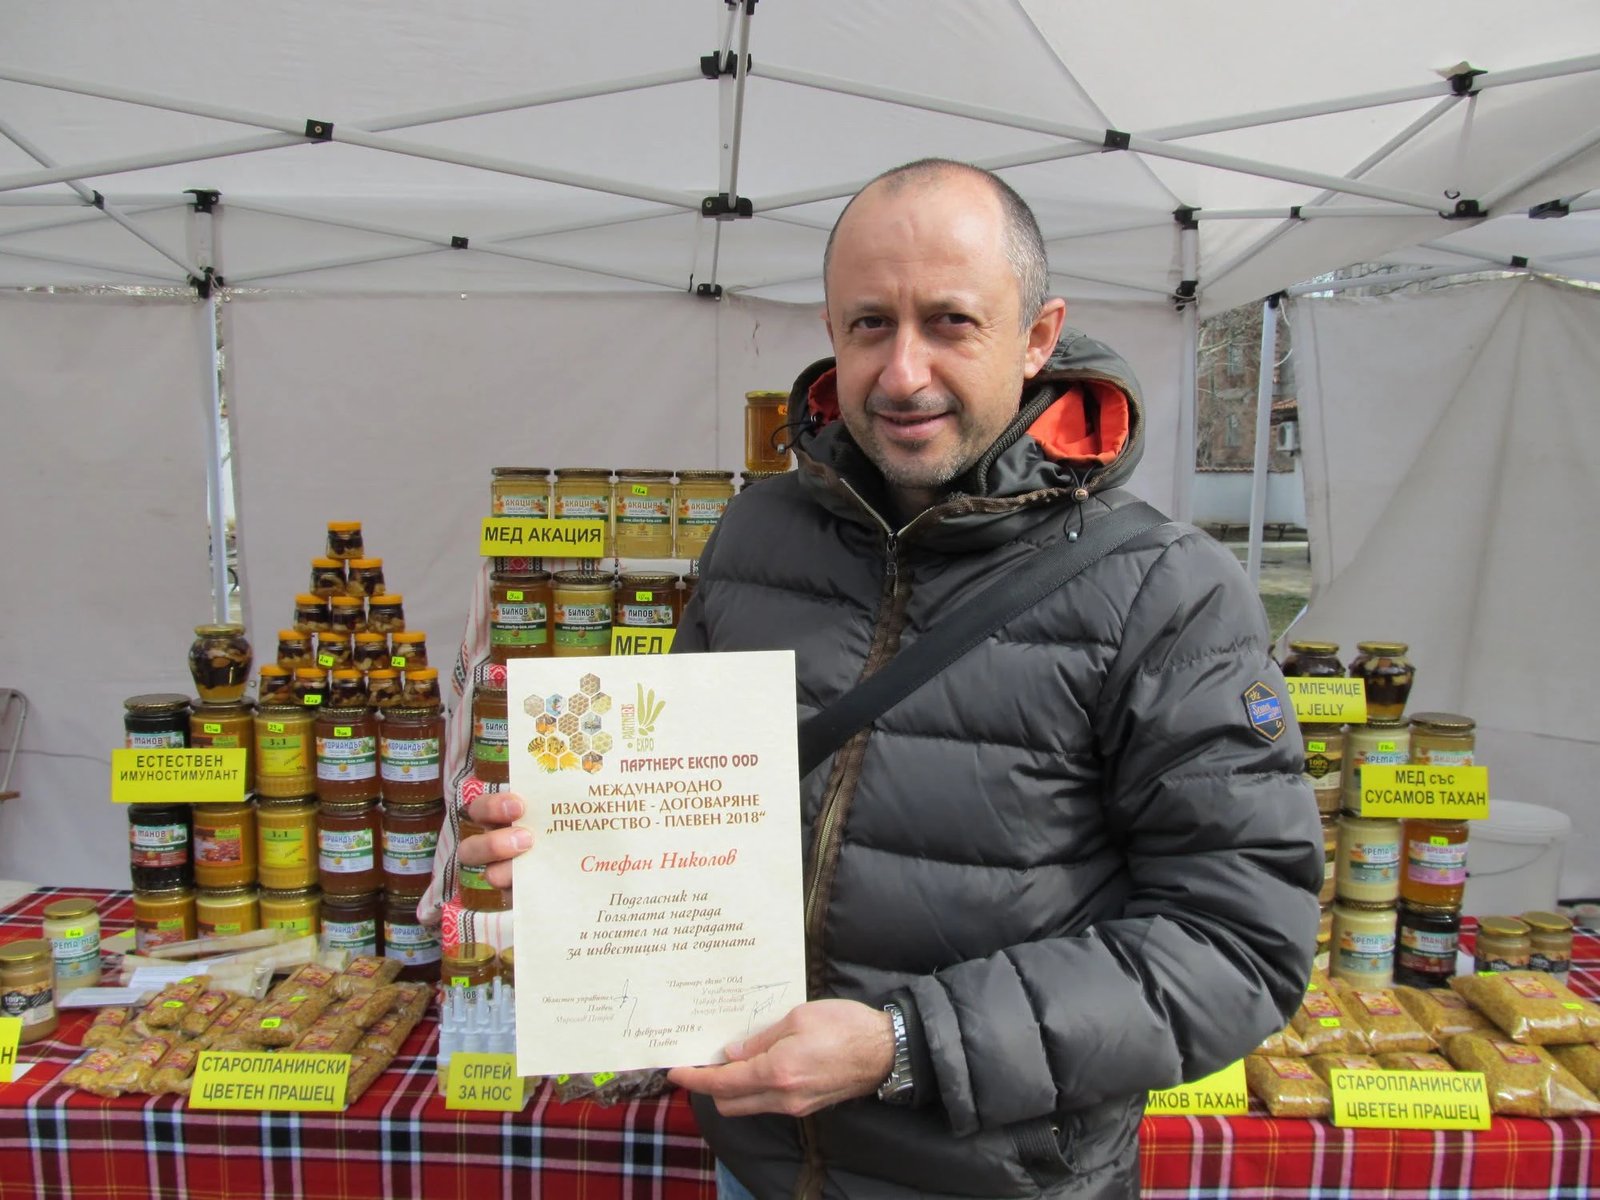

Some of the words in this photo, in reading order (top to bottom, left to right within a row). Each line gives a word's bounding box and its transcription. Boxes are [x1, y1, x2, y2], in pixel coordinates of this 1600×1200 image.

[485, 526, 522, 544] МЕД
[528, 527, 601, 545] АКАЦИЯ
[501, 607, 528, 615] БИЛКОВ
[567, 608, 595, 616] БИЛКОВ
[628, 609, 653, 617] ЛИПОВ
[616, 636, 663, 655] МЕД
[1299, 682, 1361, 697] МЛЕЧИЦЕ
[1307, 703, 1344, 716] JELLY
[636, 737, 655, 752] EXPO
[136, 755, 223, 768] ЕСТЕСТВЕН
[620, 757, 684, 773] ПАРТНЕРС
[688, 755, 728, 770] ЕКСПО
[120, 769, 238, 782] ИМУНОСТИМУЛАНТ
[1395, 770, 1426, 786] МЕД
[1429, 774, 1455, 785] със
[588, 779, 723, 798] МЕЖДУНАРОДНО
[551, 800, 646, 815] ИЗЛОЖЕНИЕ
[659, 794, 760, 814] ДОГОВАРЯНЕ
[1365, 789, 1435, 805] СУСАМОВ
[1439, 791, 1486, 806] ТАХАН
[664, 813, 721, 828] ПЛЕВЕН
[580, 854, 652, 875] Стефан
[661, 848, 738, 870] Николов
[609, 889, 688, 909] Подгласник
[692, 892, 709, 902] на
[596, 909, 666, 923] Голямата
[670, 906, 722, 921] награда
[579, 931, 588, 940] и
[593, 928, 647, 940] носител
[652, 926, 668, 936] на
[673, 921, 744, 937] наградата
[566, 947, 581, 961] за
[586, 942, 667, 956] инвестиция
[672, 941, 688, 951] на
[692, 936, 756, 952] годината
[635, 1027, 673, 1037] февруари
[675, 1024, 695, 1033] 2018
[648, 1039, 678, 1048] Плевен
[201, 1056, 347, 1075] СТАРОПЛАНИНСКИ
[463, 1062, 512, 1080] СПРЕЙ
[1336, 1074, 1483, 1093] СТАРОПЛАНИНСКИ
[202, 1083, 265, 1102] ЦВЕТЕН
[268, 1085, 335, 1104] ПРАШЕЦ
[458, 1085, 477, 1100] ЗА
[481, 1085, 512, 1101] НОС
[1194, 1092, 1246, 1109] ТАХАН
[1346, 1101, 1408, 1120] ЦВЕТЕН
[1413, 1103, 1481, 1123] ПРАШЕЦ
